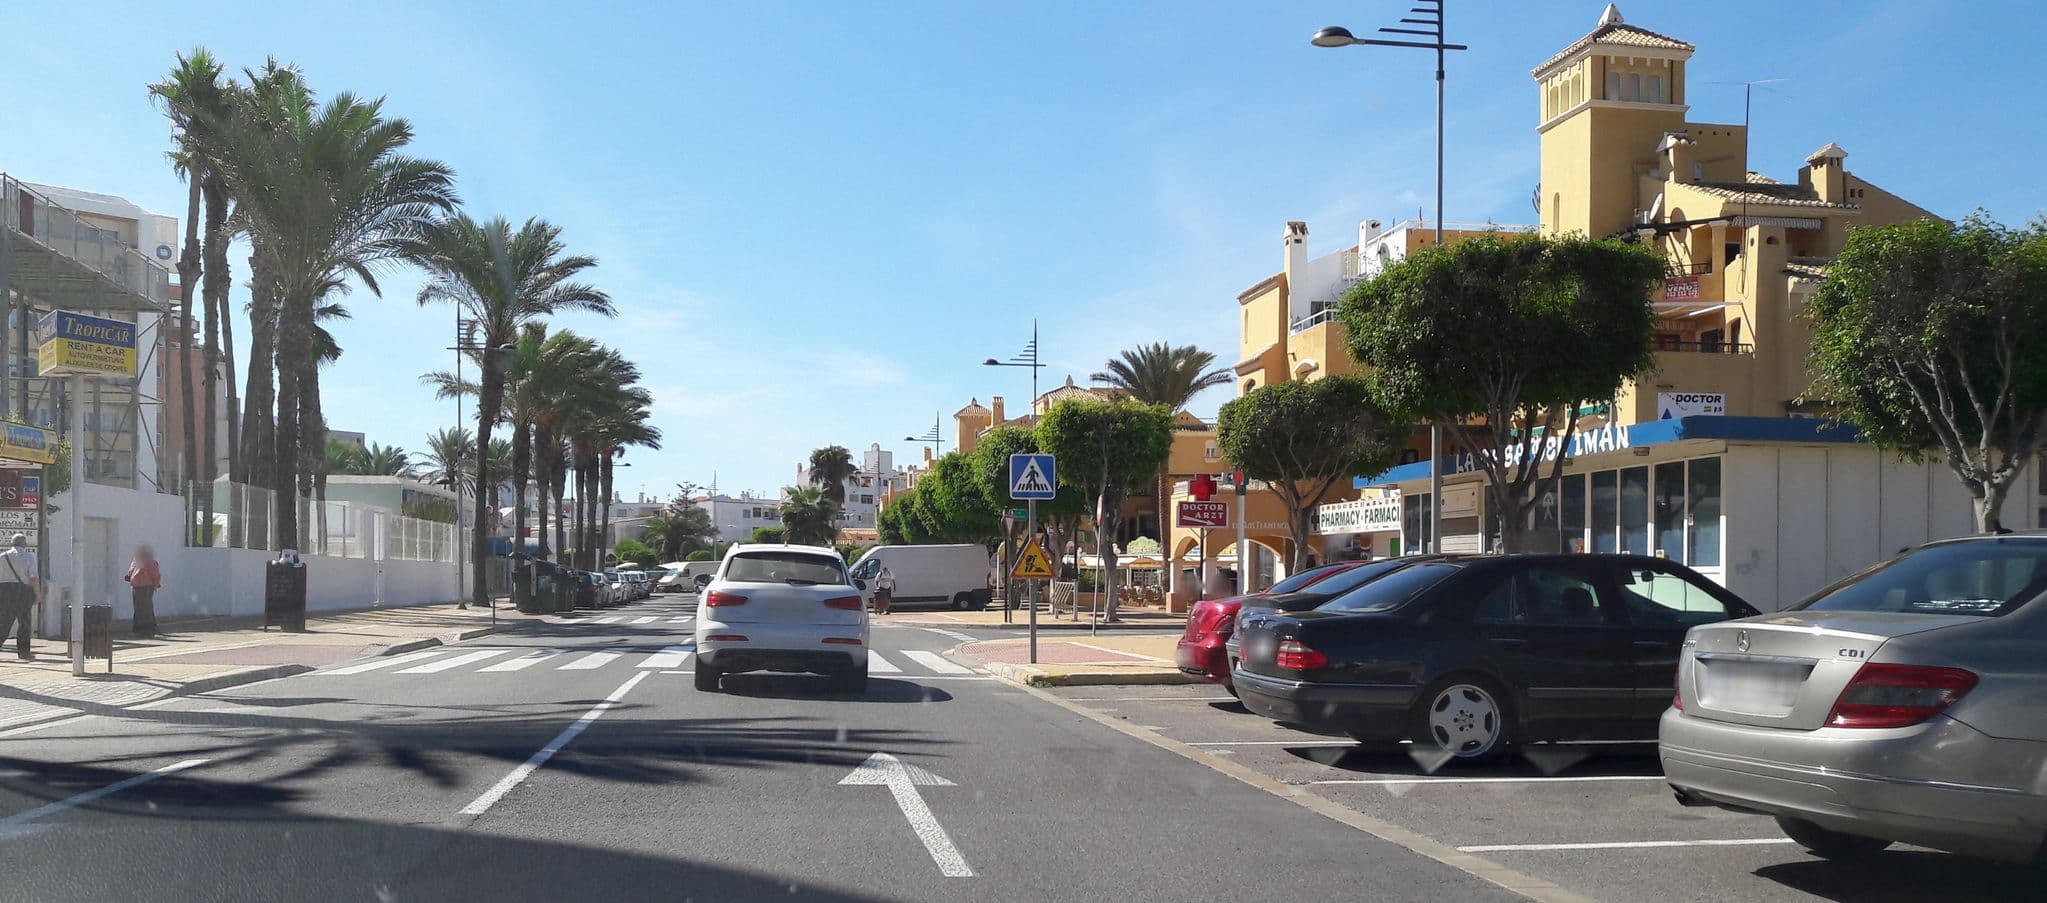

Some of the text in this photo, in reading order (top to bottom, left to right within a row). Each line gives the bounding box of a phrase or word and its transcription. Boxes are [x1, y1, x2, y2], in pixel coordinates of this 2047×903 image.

[64, 317, 129, 342] TROPICAR
[67, 341, 94, 353] RENT
[105, 346, 125, 357] CAR
[1676, 394, 1722, 403] DOCTOR
[1456, 453, 1475, 474] LA
[1183, 503, 1225, 511] DOCTOR
[1321, 510, 1361, 527] PHARMACY
[1838, 648, 1865, 658] CDI
